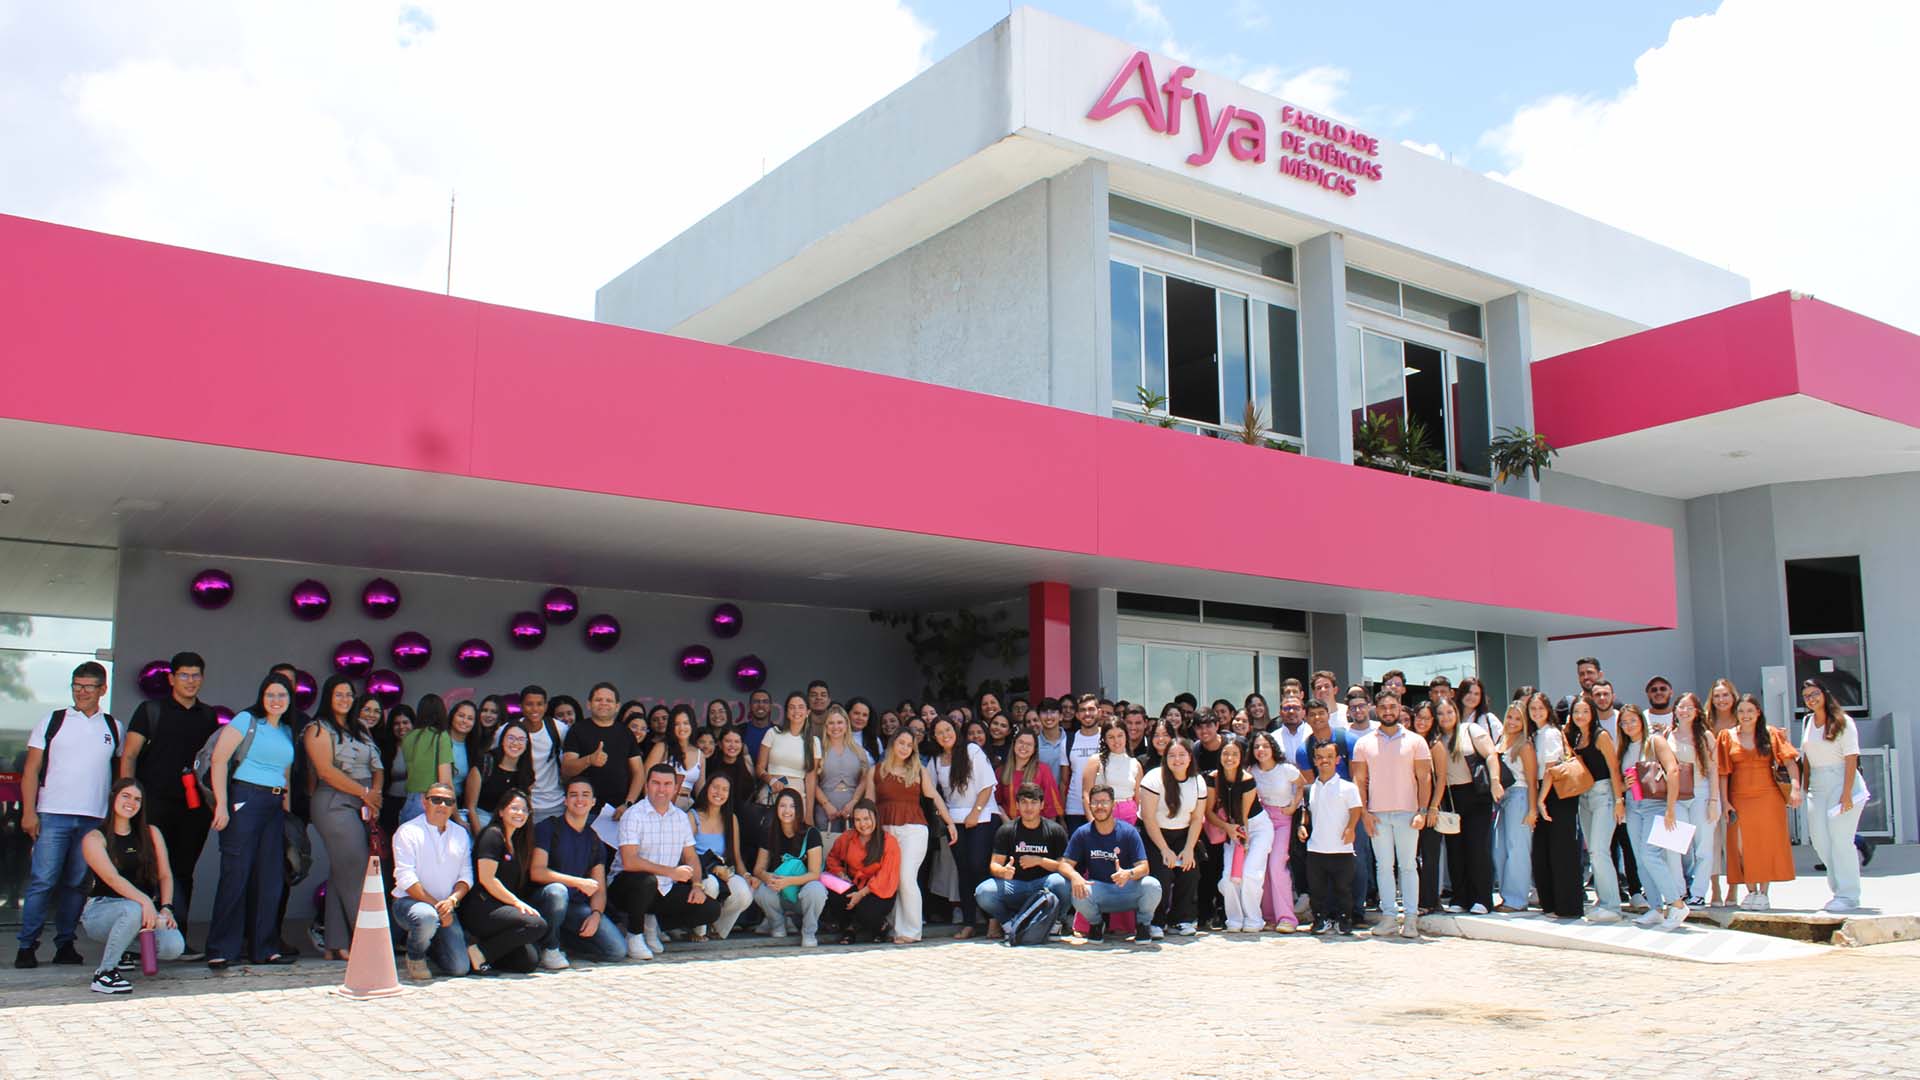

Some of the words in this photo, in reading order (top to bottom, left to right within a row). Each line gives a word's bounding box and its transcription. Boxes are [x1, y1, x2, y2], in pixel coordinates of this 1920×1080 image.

[1087, 51, 1266, 167] Afya
[1281, 106, 1379, 157] FACULDADE
[1280, 155, 1357, 197] MÉDICAS
[1281, 130, 1306, 155] DE
[1308, 141, 1382, 181] CIÊNCIAS
